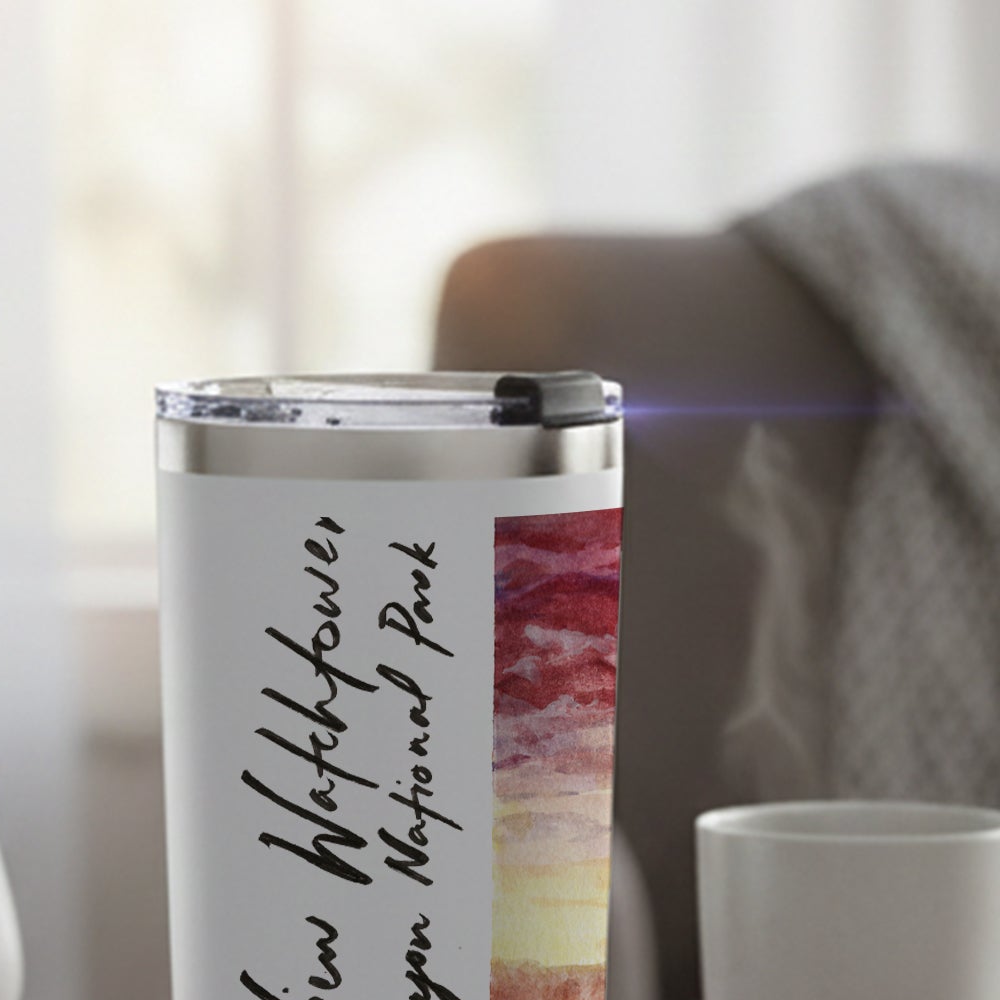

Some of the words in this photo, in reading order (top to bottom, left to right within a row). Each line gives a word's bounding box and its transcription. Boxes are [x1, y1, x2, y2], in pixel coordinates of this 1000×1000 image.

[240, 516, 380, 886] Watchtower
[377, 541, 455, 658] Park
[375, 663, 465, 887] National
